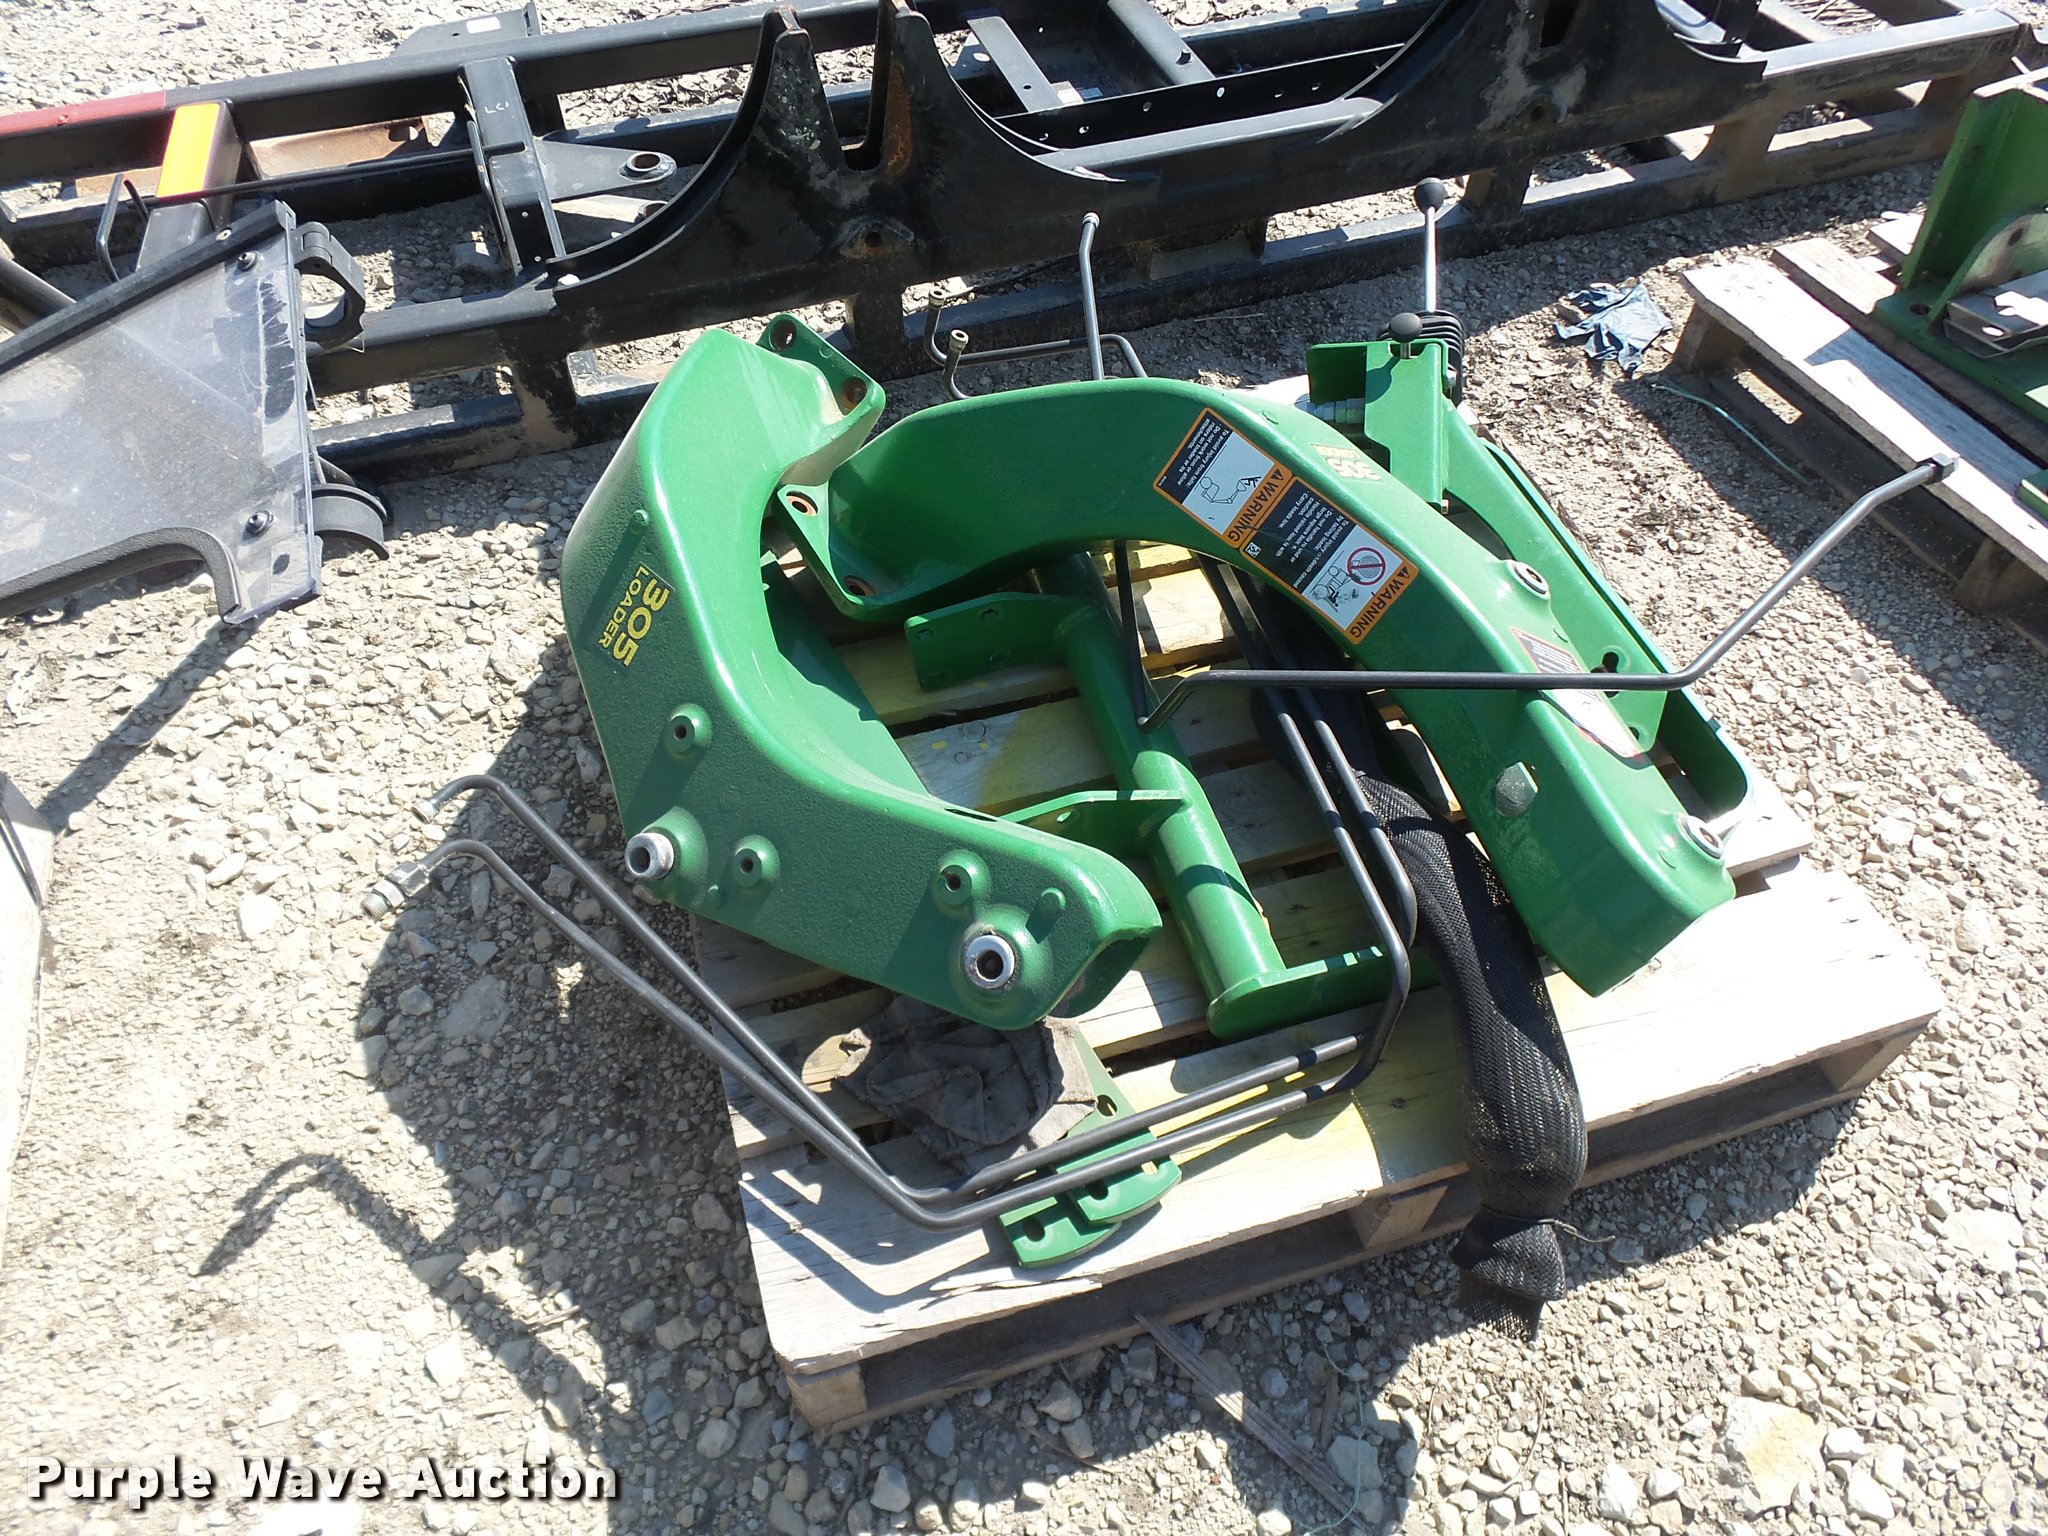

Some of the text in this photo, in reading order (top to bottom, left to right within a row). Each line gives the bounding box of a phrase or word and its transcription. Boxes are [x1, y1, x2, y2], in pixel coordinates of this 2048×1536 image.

[1202, 421, 1215, 437] riders
[1221, 428, 1229, 436] To
[1197, 436, 1205, 445] on
[1211, 434, 1224, 450] avoid
[1176, 425, 1220, 485] Do not work from or allow
[1186, 443, 1200, 460] loader
[1201, 448, 1214, 464] injury
[1182, 458, 1189, 466] or
[1193, 462, 1204, 476] from
[1295, 492, 1308, 507] Carry
[1226, 479, 1279, 542] WARNING
[1304, 501, 1320, 518] Handle
[1314, 506, 1327, 520] large
[1323, 510, 1332, 519] Do
[1317, 517, 1326, 527] not
[1336, 514, 1344, 522] by
[1340, 519, 1349, 527] To
[1304, 525, 1320, 542] handle
[1330, 525, 1343, 540] avoid
[1319, 538, 1333, 553] injury
[598, 566, 650, 649] LOADER
[1349, 576, 1403, 638] WARNING
[613, 578, 670, 667] 305
